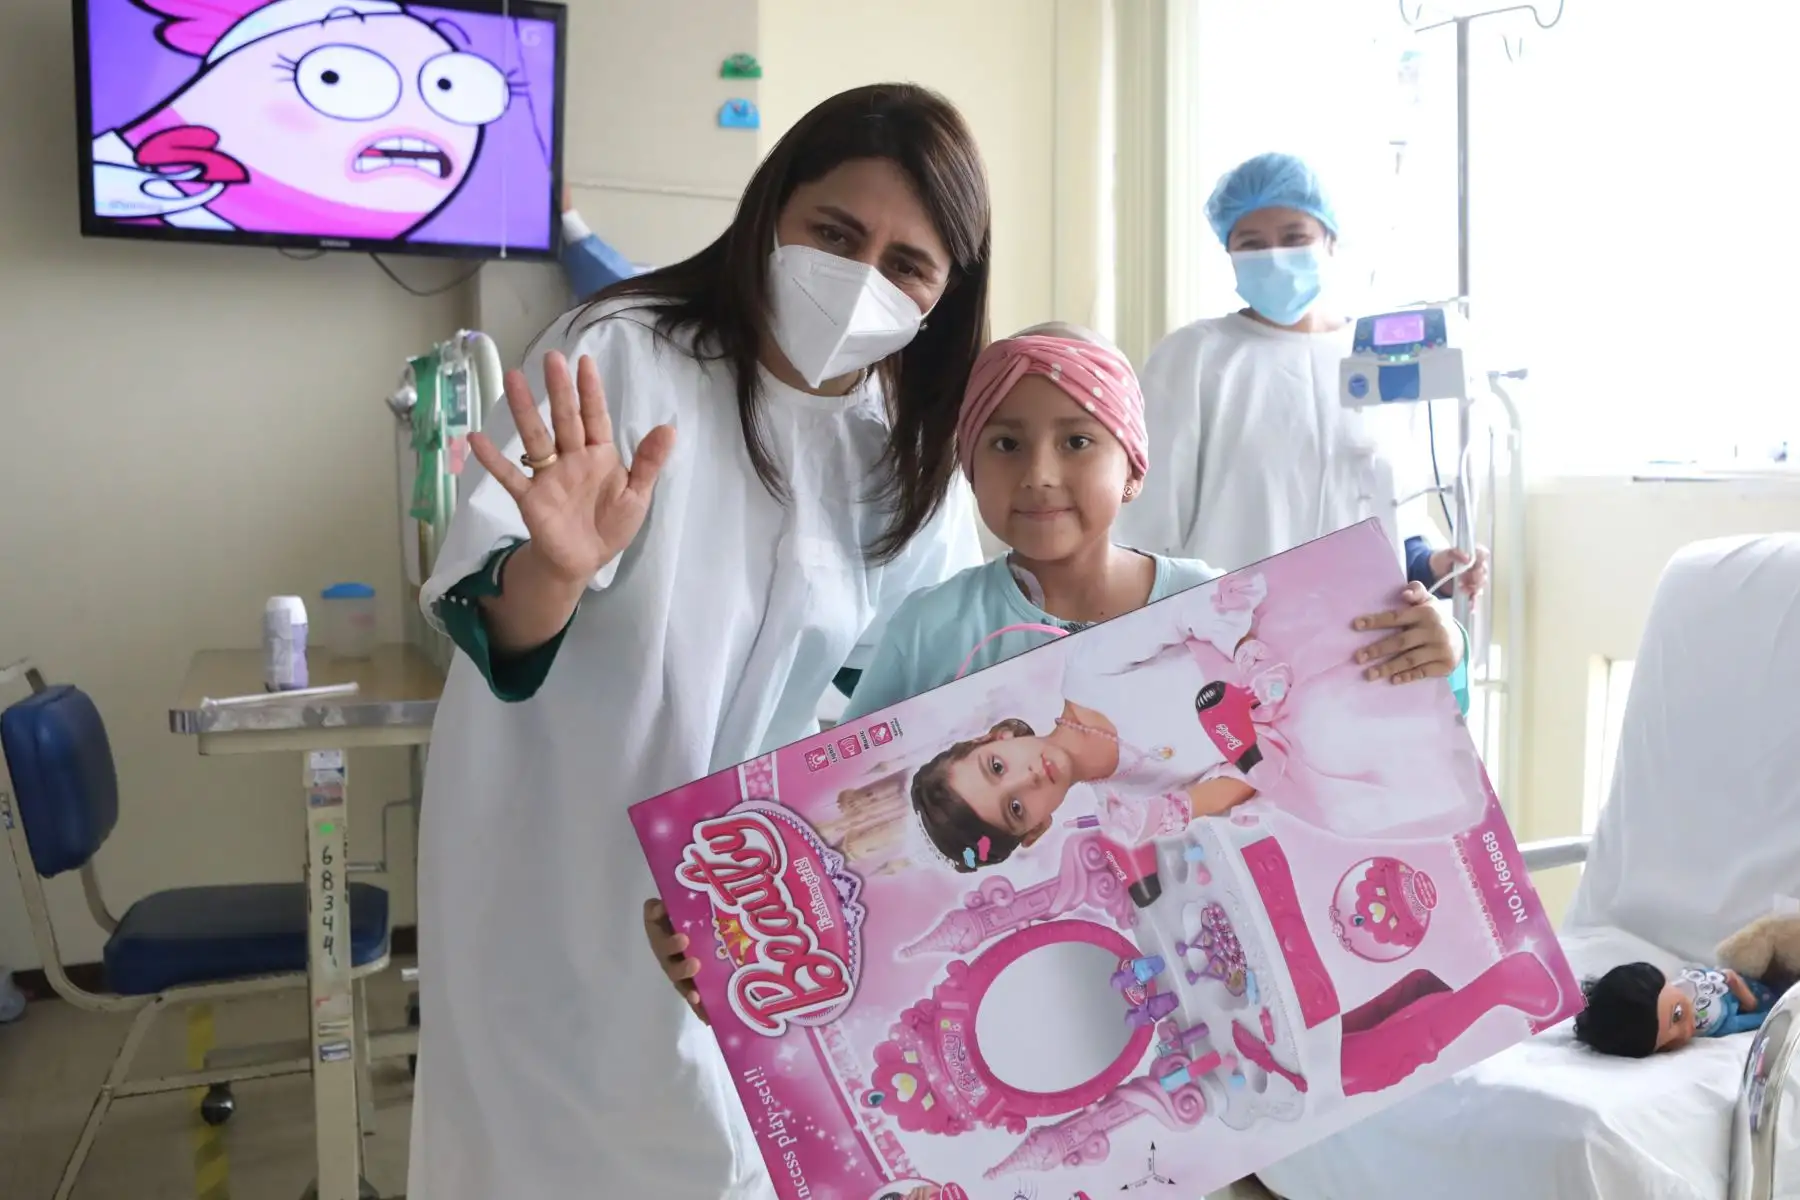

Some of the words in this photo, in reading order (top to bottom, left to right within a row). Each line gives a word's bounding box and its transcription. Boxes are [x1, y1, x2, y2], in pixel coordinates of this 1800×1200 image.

[827, 743, 838, 763] Lights
[793, 857, 820, 887] girls!
[1482, 831, 1528, 923] NO.V66868
[679, 814, 851, 1031] Beauty
[810, 884, 834, 932] Fashion
[783, 1150, 812, 1200] ncess
